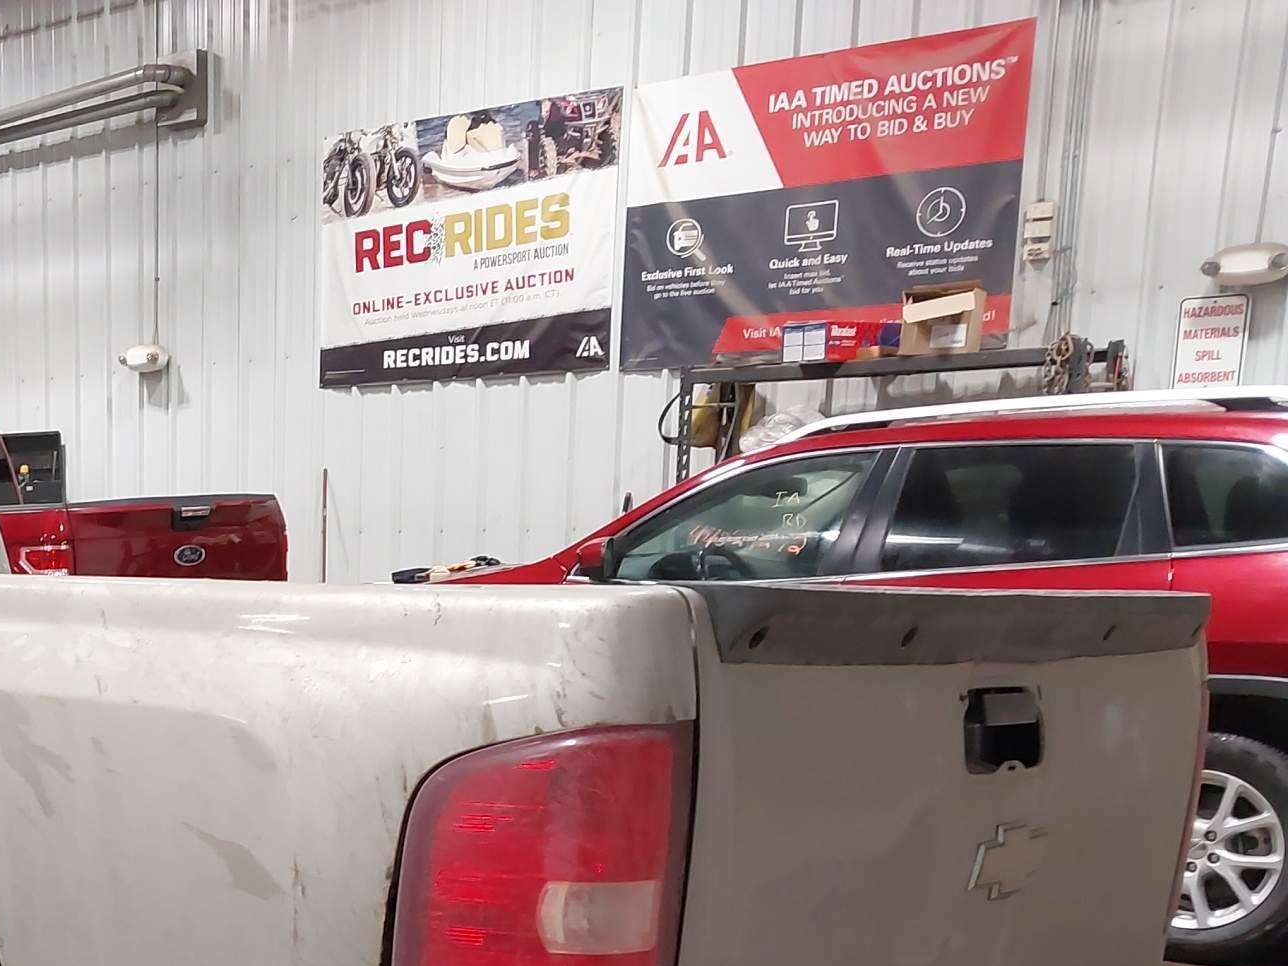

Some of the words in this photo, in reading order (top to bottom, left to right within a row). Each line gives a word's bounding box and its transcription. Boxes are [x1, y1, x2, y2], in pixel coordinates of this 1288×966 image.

[768, 90, 807, 113] IAA
[812, 79, 879, 106] TIMED
[792, 96, 917, 129] INTRODUCING
[922, 94, 938, 110] A
[943, 85, 991, 108] NEW
[803, 127, 843, 148] WAY
[848, 123, 871, 141] TO
[877, 118, 908, 138] BID
[913, 117, 928, 133] &
[933, 108, 975, 130] BUY
[354, 219, 433, 273] REC
[444, 192, 570, 258] RIDES
[473, 259, 479, 271] A
[480, 251, 532, 270] POWERSPORT
[533, 243, 569, 261] AUCTION
[885, 243, 941, 258] Real-Time
[943, 239, 993, 253] Updates
[769, 257, 799, 270] Quick
[802, 255, 821, 267] and
[823, 252, 849, 267] Easy
[641, 267, 683, 281] Exclusive
[684, 265, 705, 277] First
[709, 263, 734, 275] Look
[352, 281, 500, 316] ONLINE-EXCLUSIVE
[504, 268, 575, 293] AUCTION
[1183, 304, 1244, 319] HAZARDOUS
[448, 335, 466, 344] Visit
[743, 327, 767, 339] Visit
[1183, 326, 1240, 340] MATERIALS
[383, 339, 531, 369] RECRIDES.COM
[1194, 350, 1222, 362] SPILL
[1176, 370, 1236, 384] ABSORBENT
